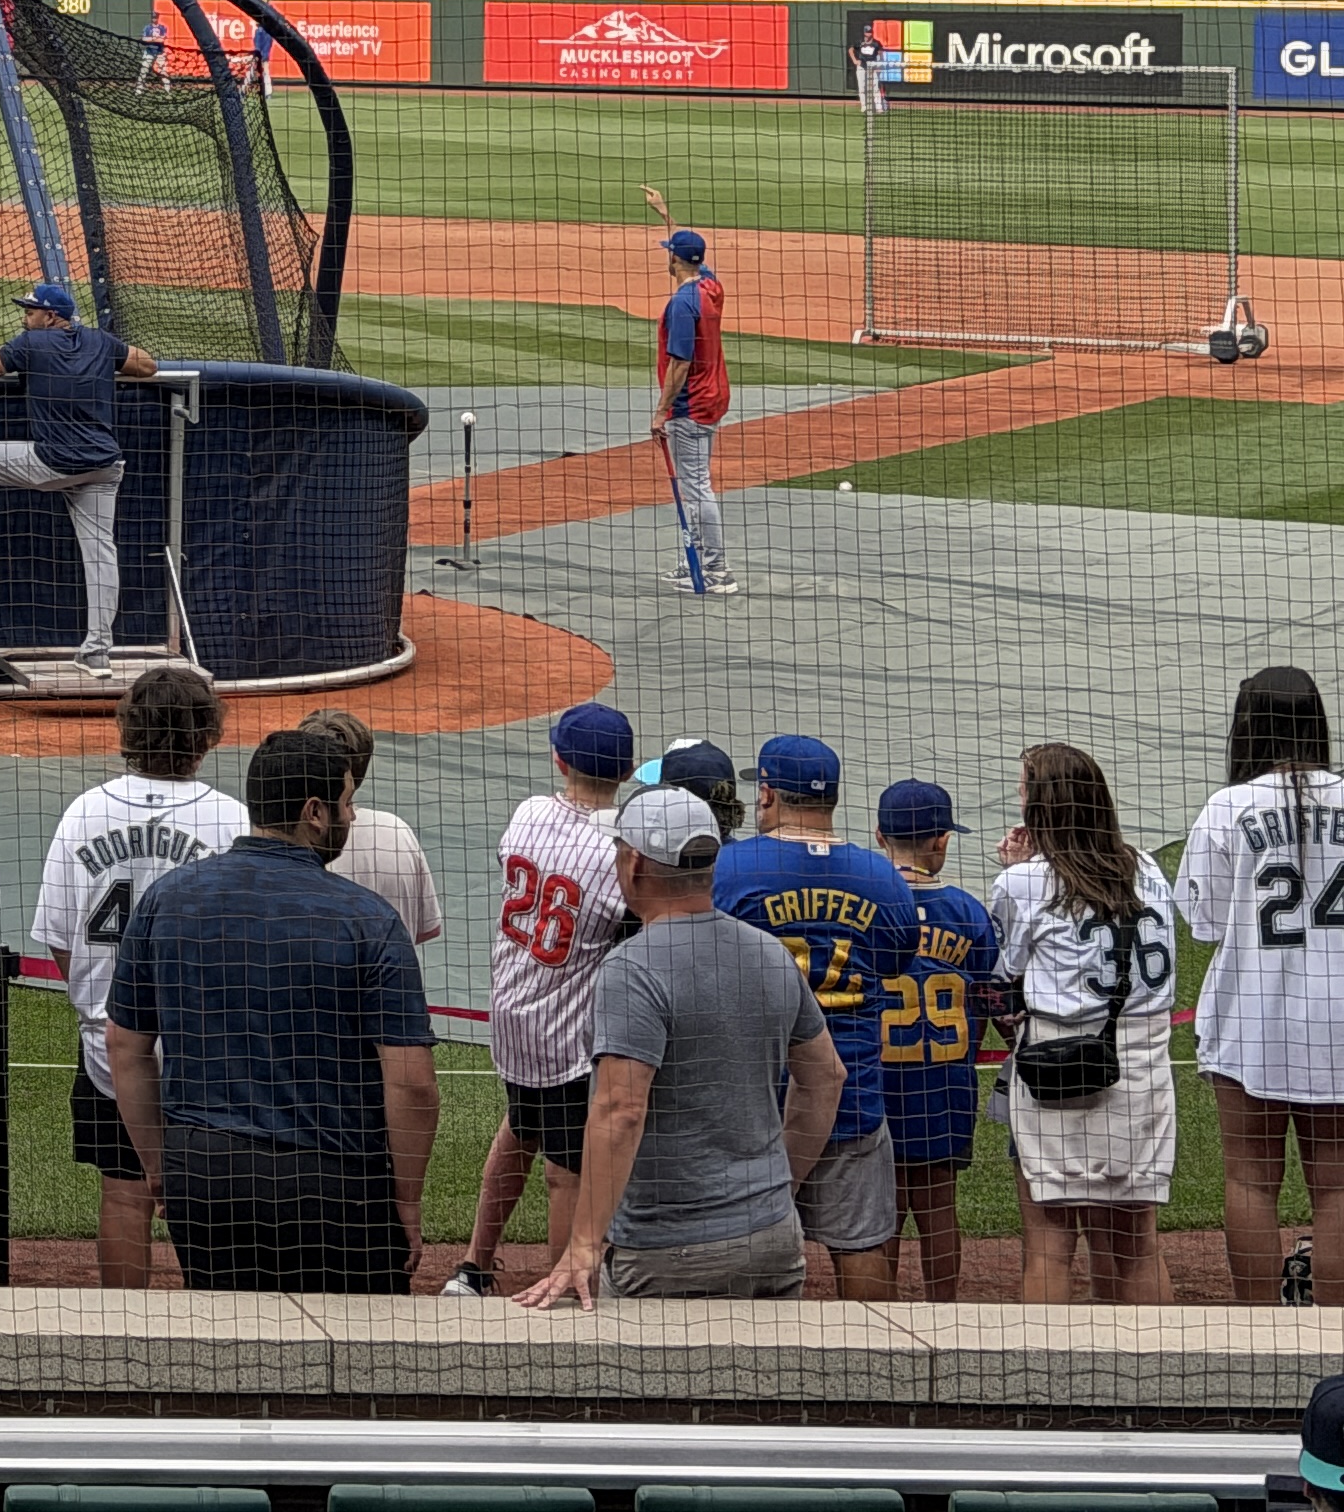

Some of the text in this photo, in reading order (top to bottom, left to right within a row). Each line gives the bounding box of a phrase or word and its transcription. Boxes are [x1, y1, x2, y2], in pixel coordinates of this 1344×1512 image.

[297, 21, 379, 39] Experience
[361, 40, 382, 56] TV
[560, 46, 695, 66] MUCKLESHOOT
[560, 68, 695, 81] CASINO RESORT
[947, 32, 1156, 75] Microsoft
[500, 854, 584, 967] 26
[765, 888, 877, 932] GRIFFEY
[1256, 863, 1344, 949] 24
[1078, 908, 1171, 1000] 36
[881, 973, 969, 1063] 29
